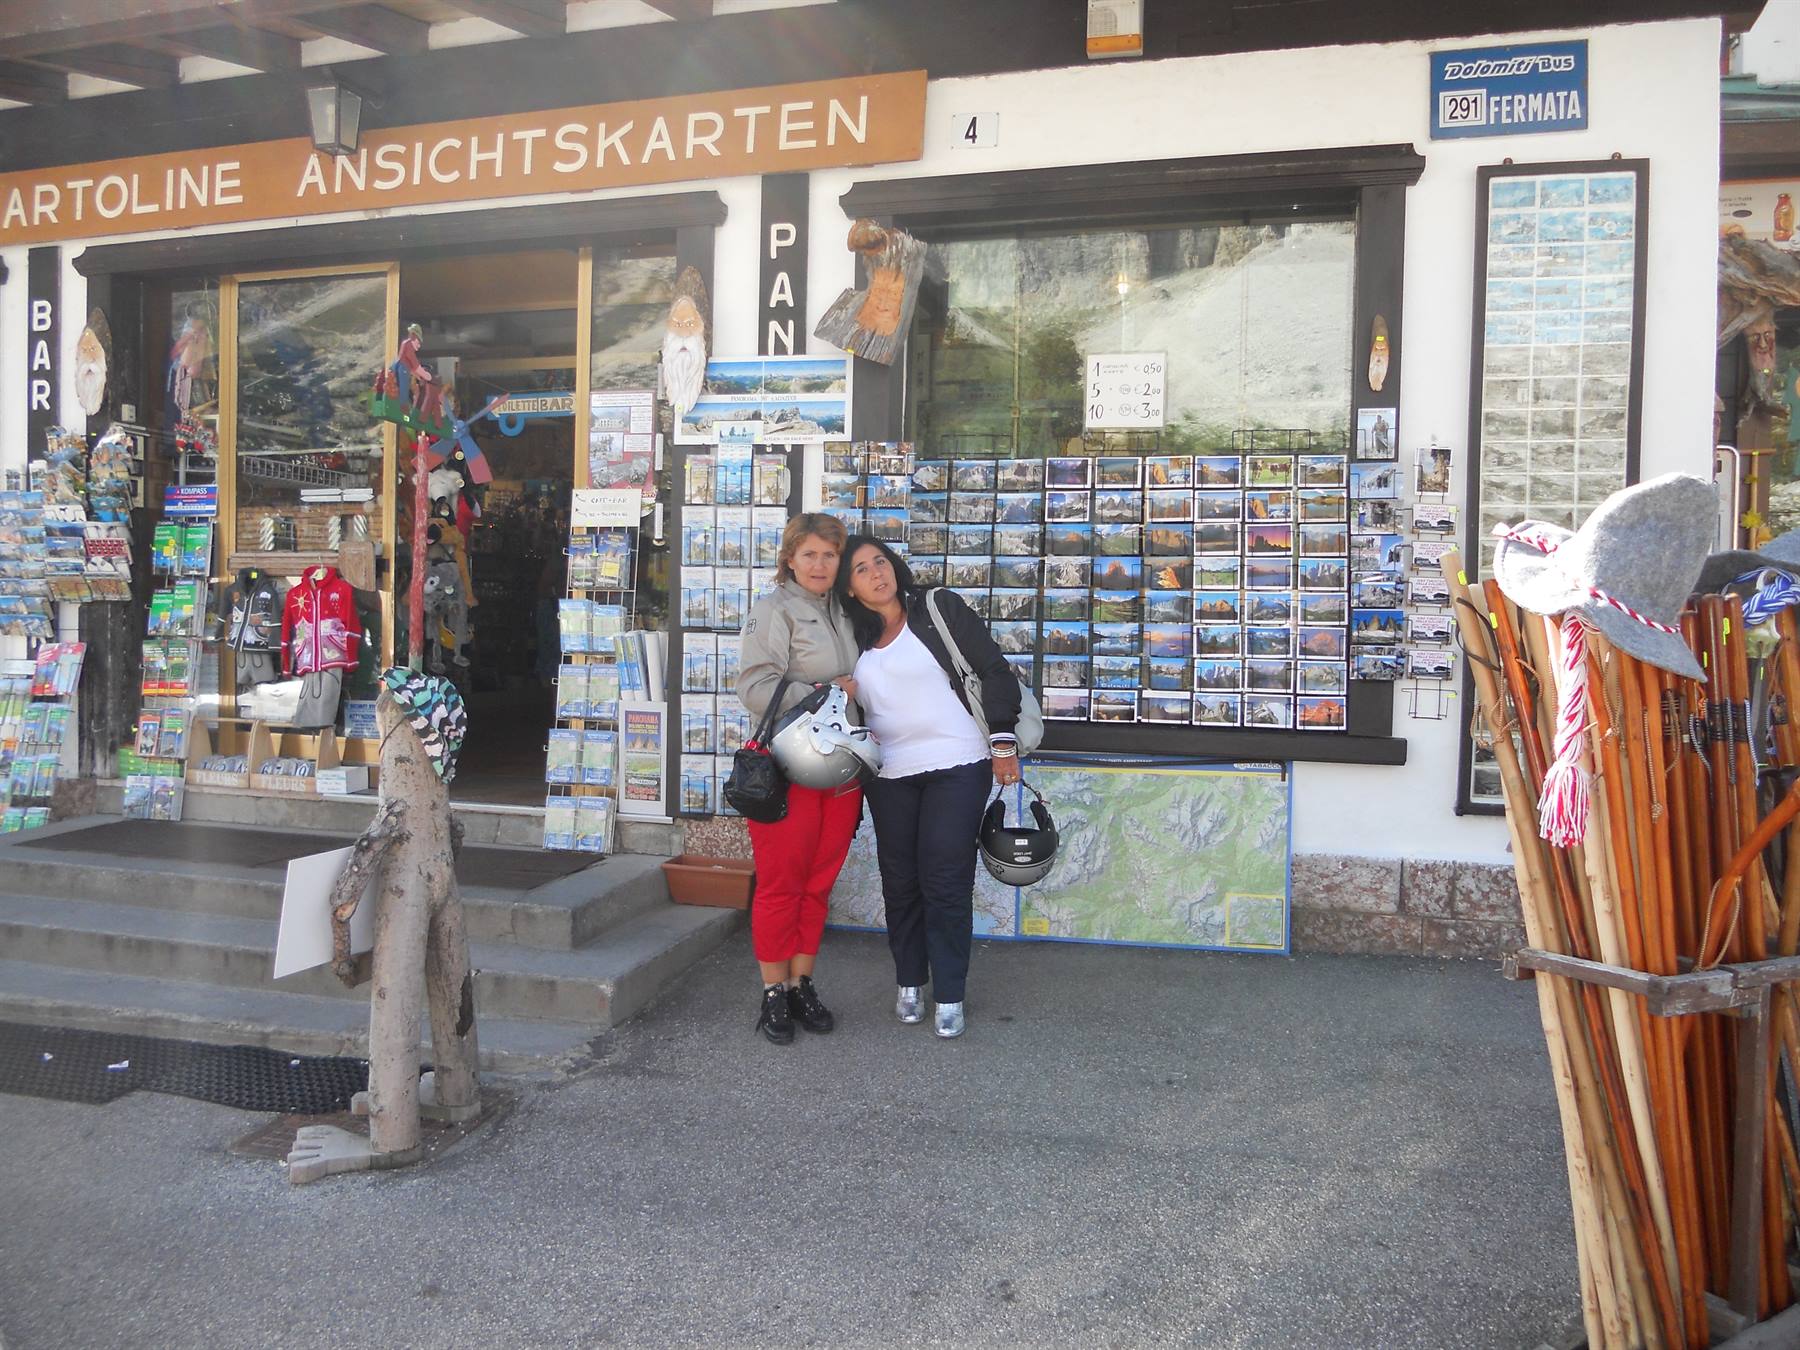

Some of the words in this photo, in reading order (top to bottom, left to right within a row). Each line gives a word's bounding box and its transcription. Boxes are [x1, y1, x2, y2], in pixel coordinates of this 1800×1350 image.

[1444, 56, 1536, 80] Dolomiti
[1538, 55, 1575, 73] Bus
[1448, 96, 1479, 120] 291
[1489, 90, 1581, 124] FERMATA
[964, 116, 978, 145] 4
[297, 95, 868, 198] ANSICHTSKARTEN
[767, 223, 797, 356] PAN
[32, 300, 52, 411] BAR
[1091, 382, 1101, 398] 5
[497, 399, 537, 412] OILETTE
[540, 397, 574, 411] BAR
[1089, 404, 1104, 420] 10
[180, 487, 208, 495] KOMPASS
